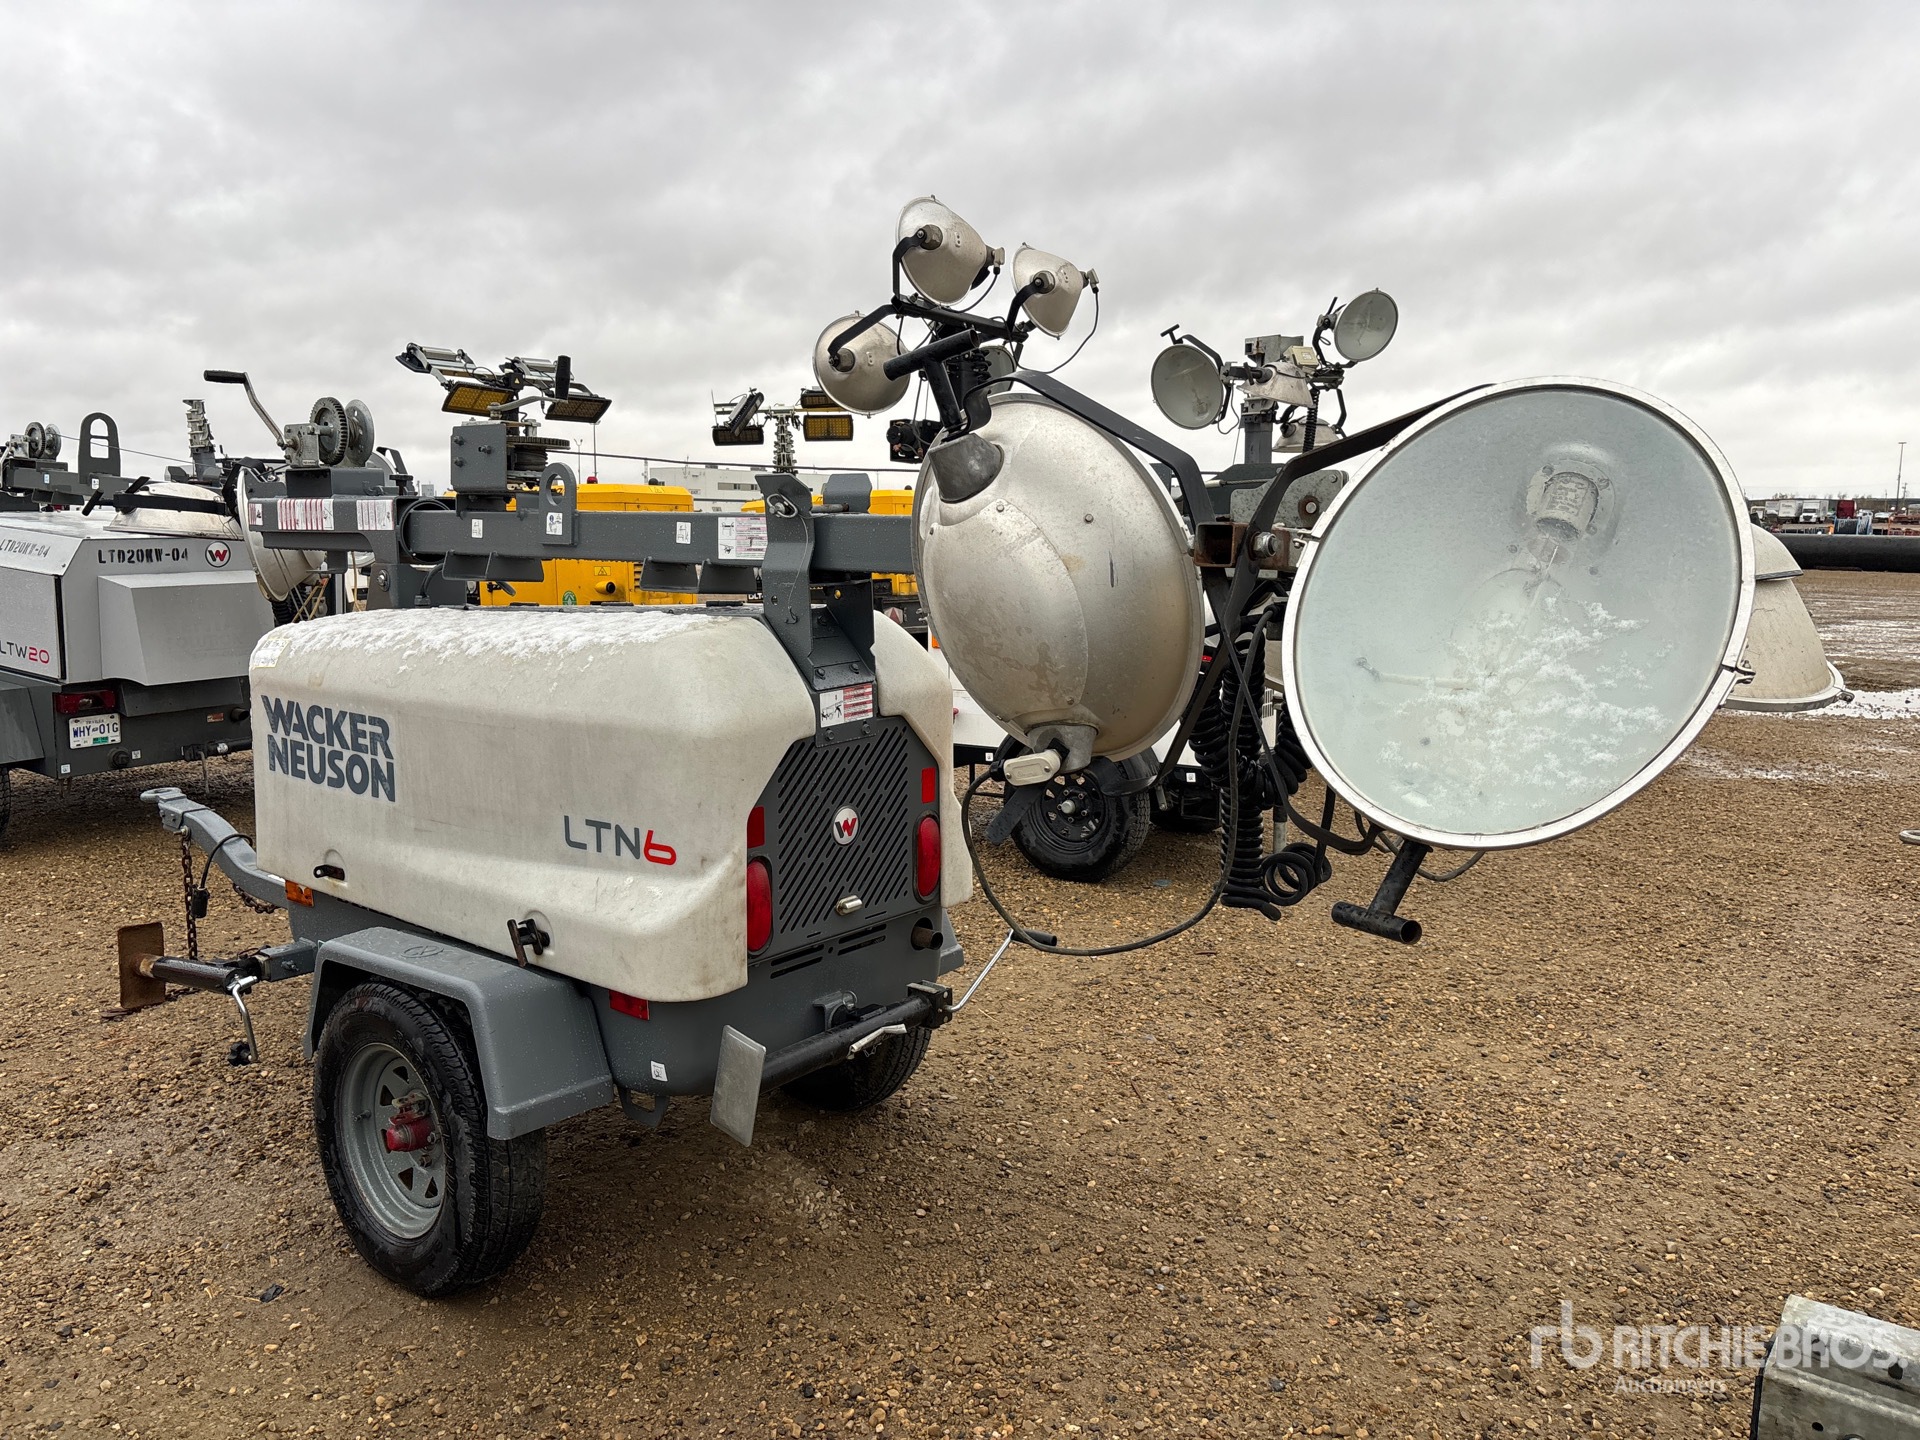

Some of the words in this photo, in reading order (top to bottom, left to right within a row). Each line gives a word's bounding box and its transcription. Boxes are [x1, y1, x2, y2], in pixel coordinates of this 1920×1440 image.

[97, 547, 189, 564] LTD20KW-04
[0, 640, 50, 664] LTW20
[72, 725, 91, 738] WHY
[260, 694, 394, 760] WACKER
[267, 734, 396, 803] NEUSON
[563, 815, 677, 866] LTN6
